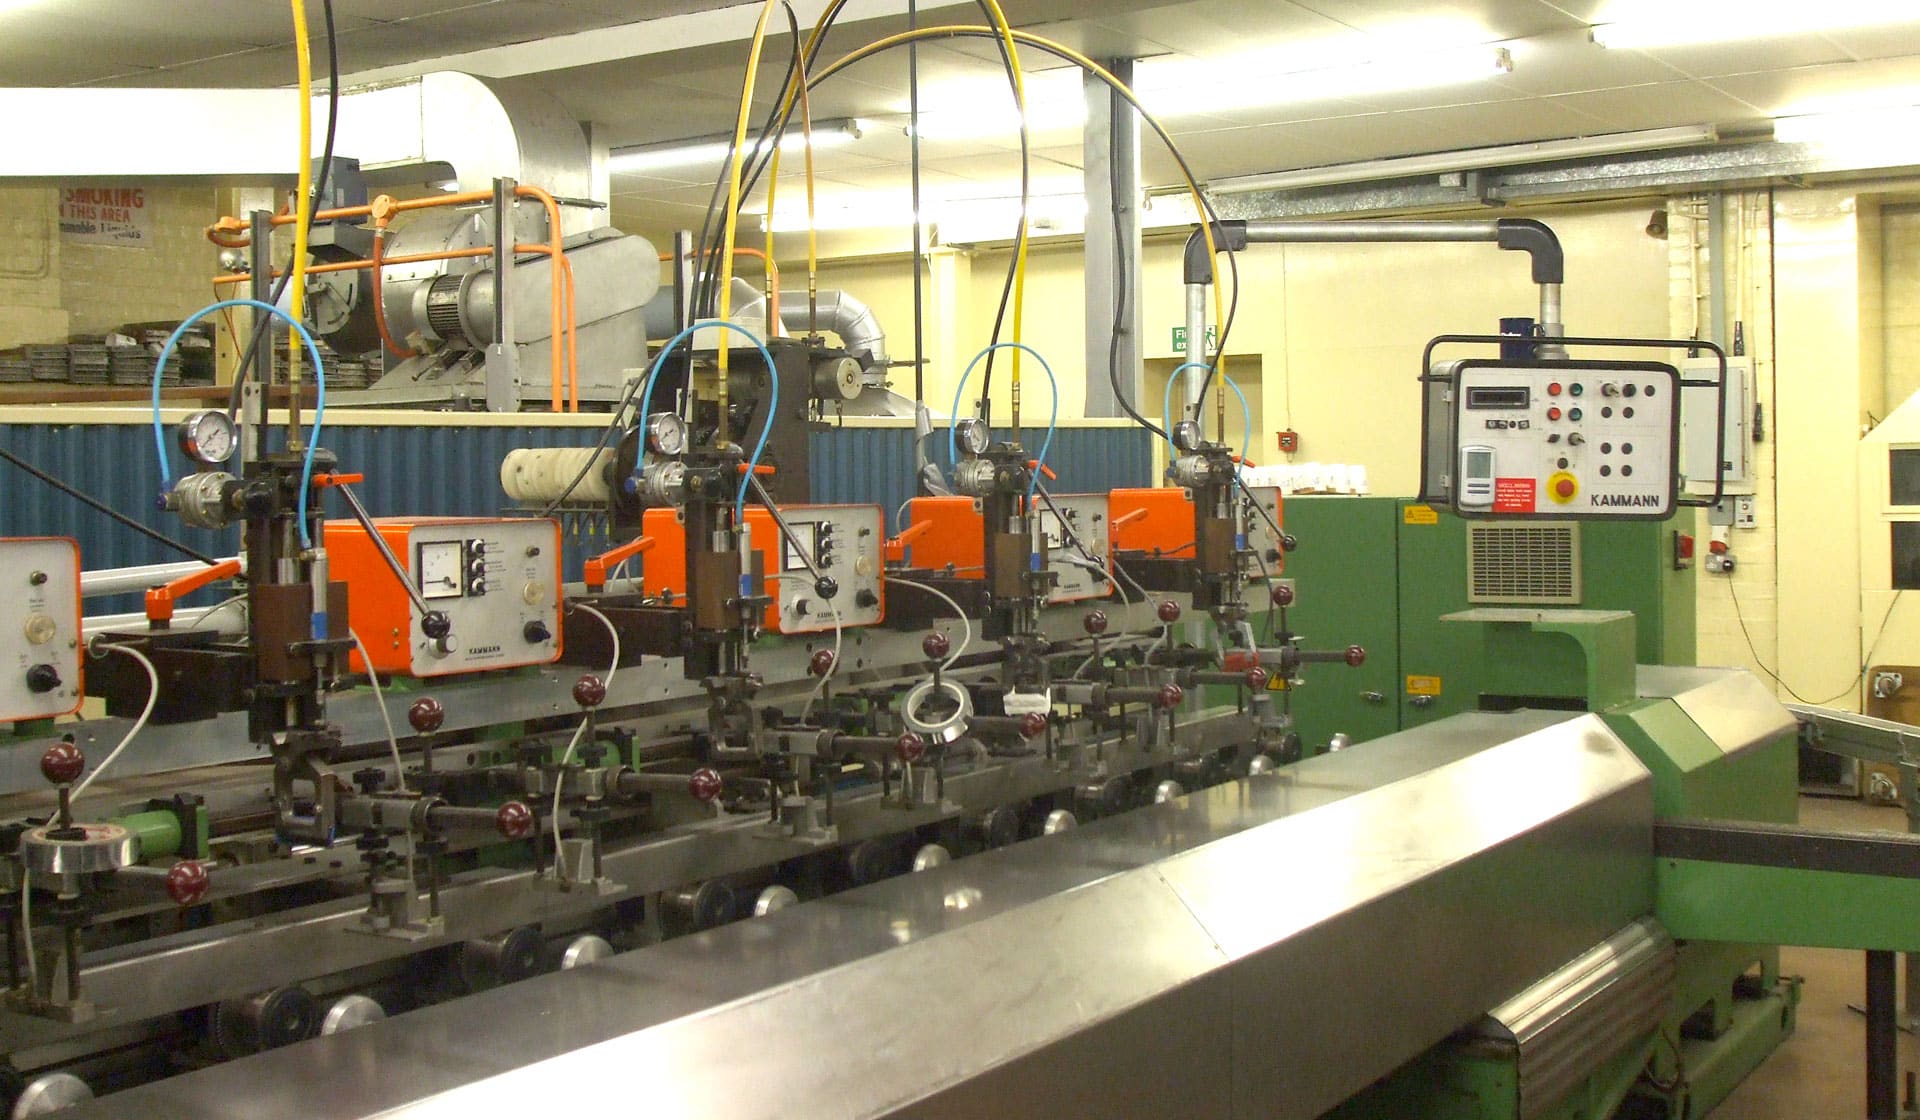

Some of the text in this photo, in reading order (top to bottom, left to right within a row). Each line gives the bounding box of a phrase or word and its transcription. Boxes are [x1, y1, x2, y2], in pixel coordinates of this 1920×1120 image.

[66, 188, 144, 208] SMOKING
[69, 204, 97, 220] THIS
[101, 208, 130, 223] AREA
[1176, 329, 1187, 339] Fi
[1590, 494, 1660, 507] KAMMANN
